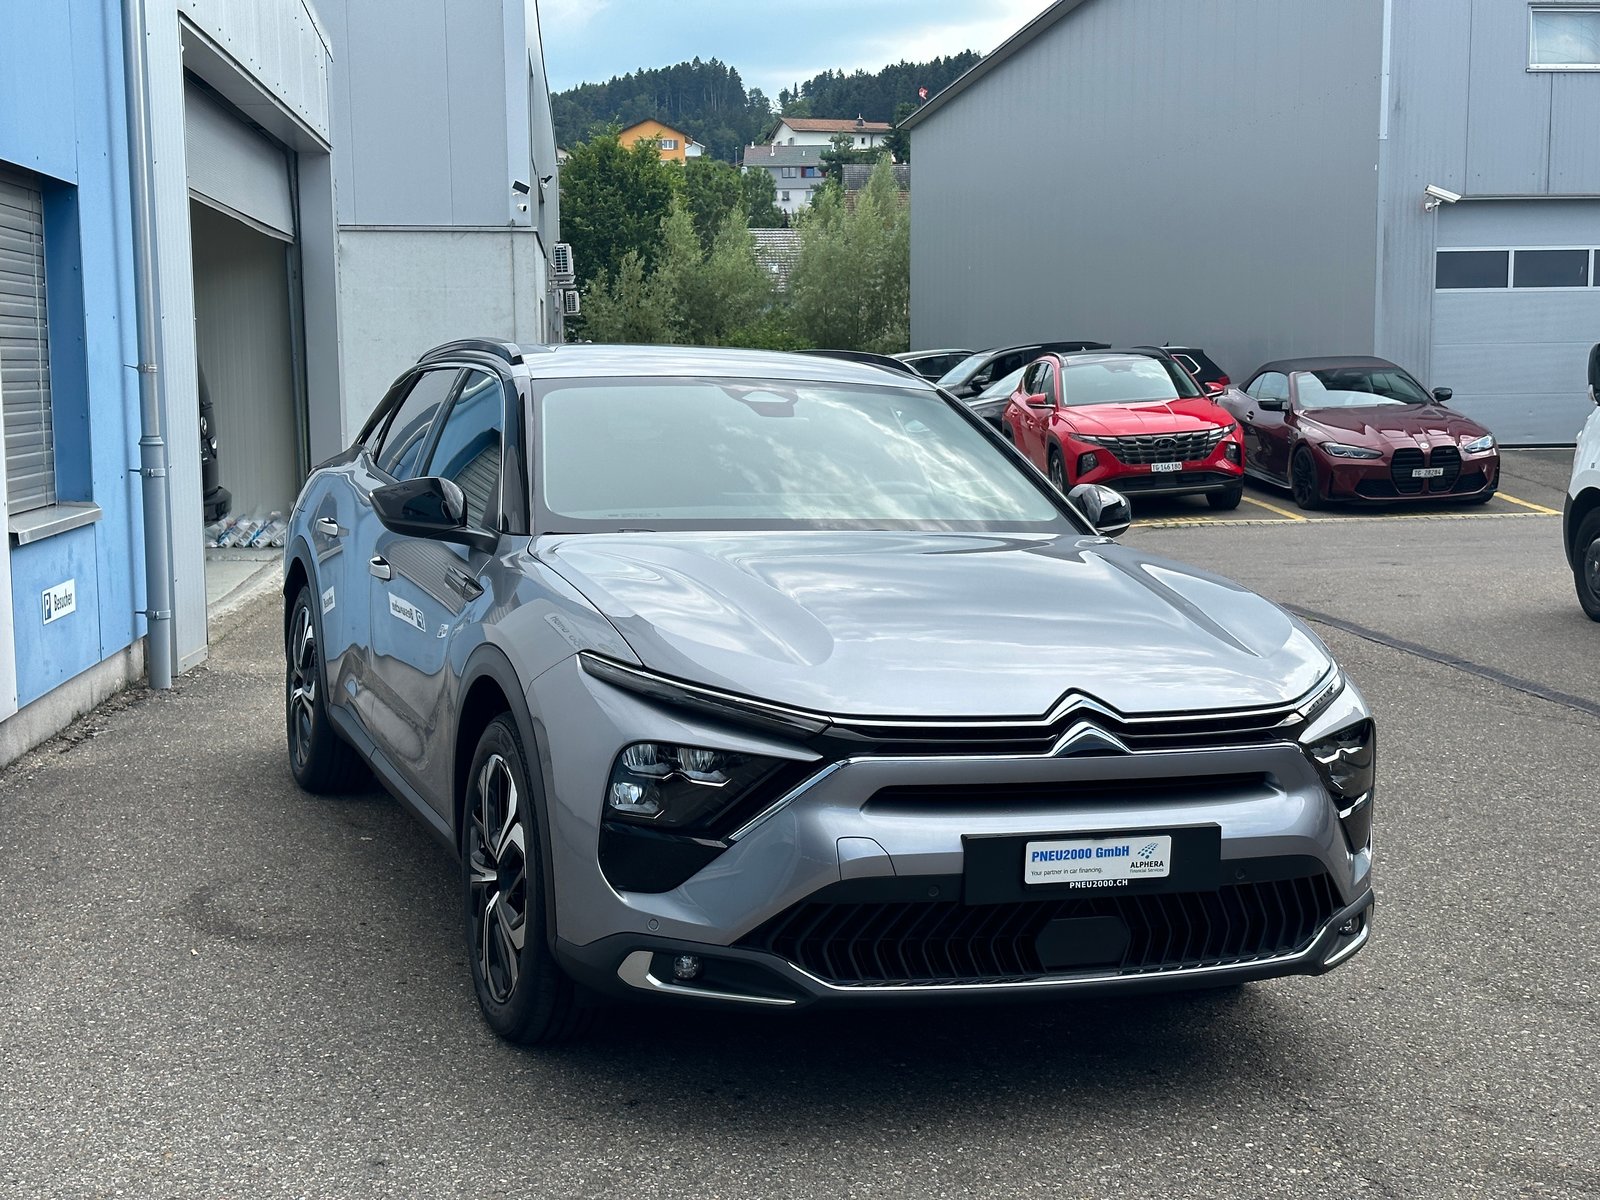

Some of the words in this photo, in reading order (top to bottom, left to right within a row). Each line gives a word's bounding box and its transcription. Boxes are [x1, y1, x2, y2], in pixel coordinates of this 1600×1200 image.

[54, 588, 73, 612] Besucher
[1032, 847, 1092, 862] PNEU2000
[1096, 845, 1130, 858] GmbH
[1130, 860, 1164, 869] ALPHERA
[1043, 869, 1063, 877] partner
[1063, 867, 1069, 875] in
[1078, 866, 1103, 874] financing.
[1069, 879, 1129, 889] PNEU2000.CH
